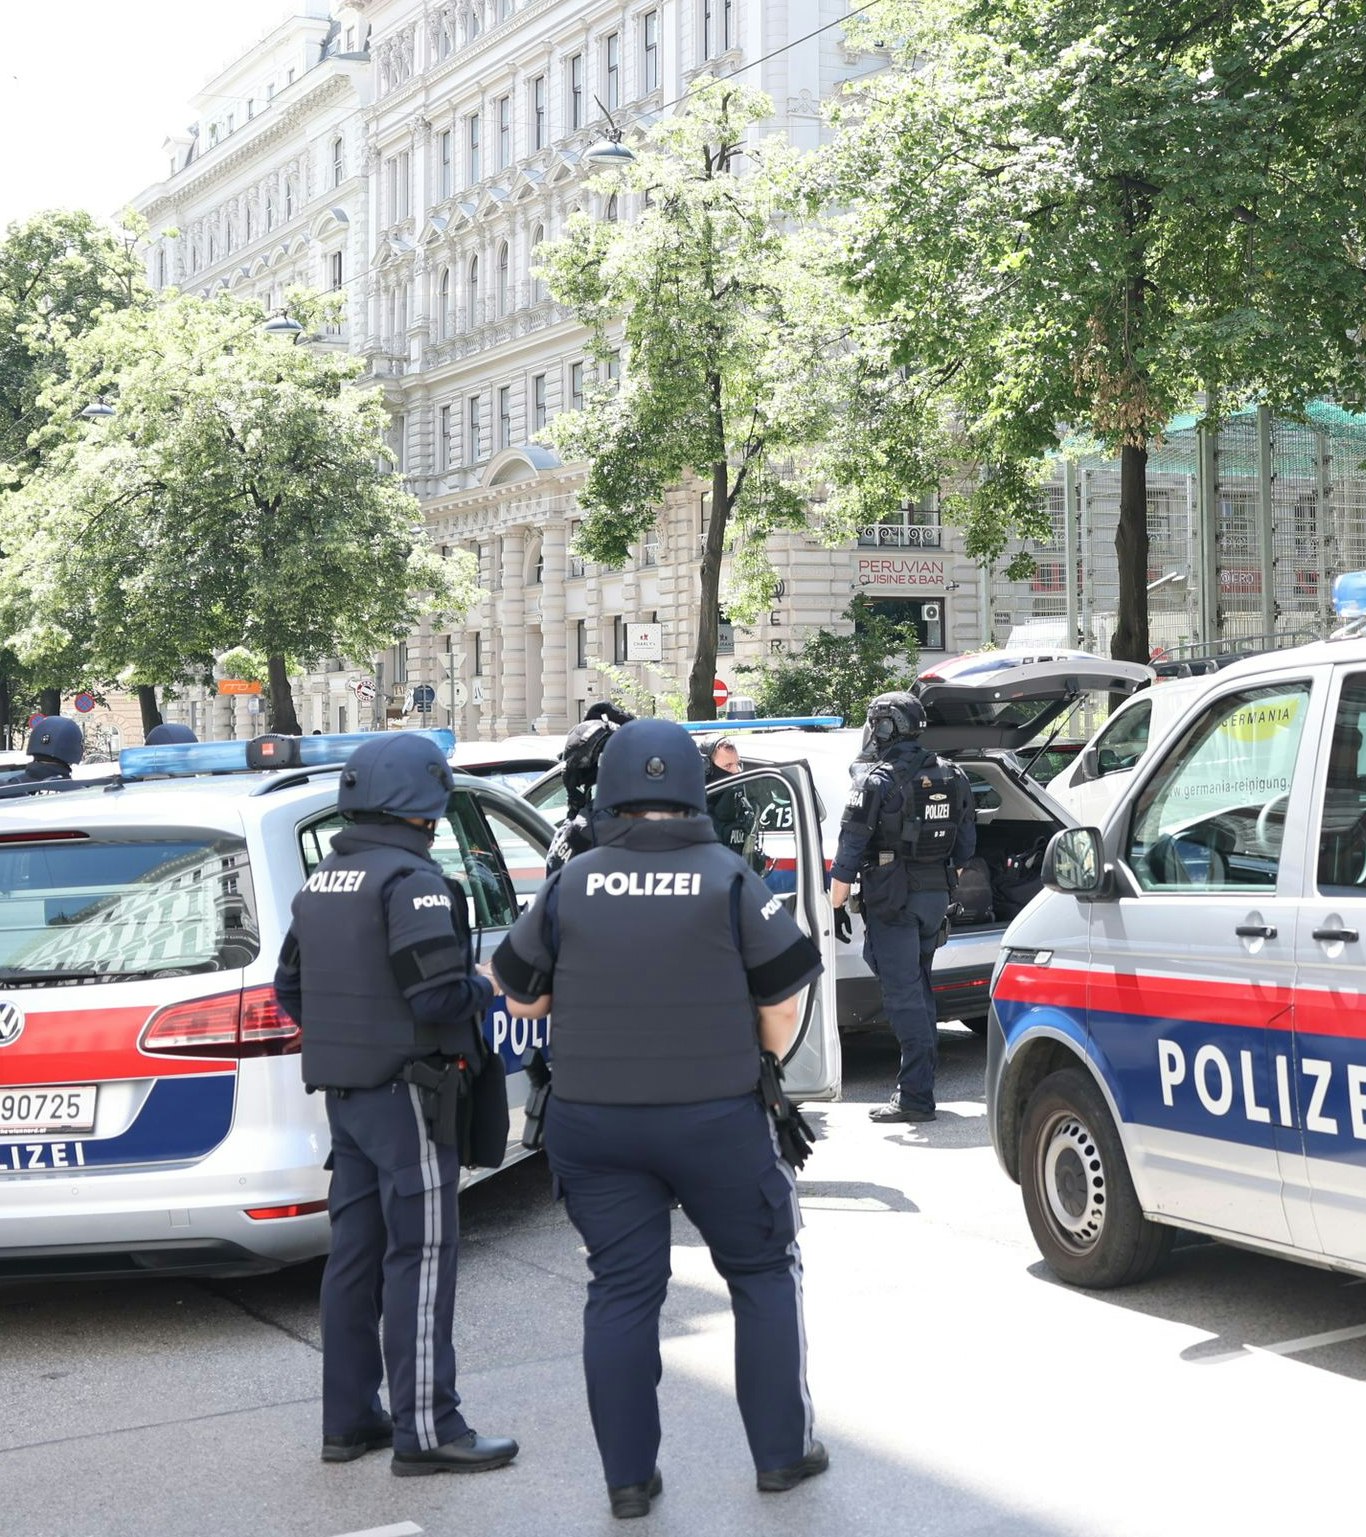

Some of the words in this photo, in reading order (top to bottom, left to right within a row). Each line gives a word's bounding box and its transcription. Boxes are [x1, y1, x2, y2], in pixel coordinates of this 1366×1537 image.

[858, 560, 944, 574] PERUVIAN
[858, 574, 905, 585] CUISINE
[907, 575, 917, 585] &
[919, 575, 944, 585] BAR
[925, 803, 950, 820] POLIZEI
[586, 871, 701, 896] POLIZEI
[1, 1093, 81, 1121] 90725
